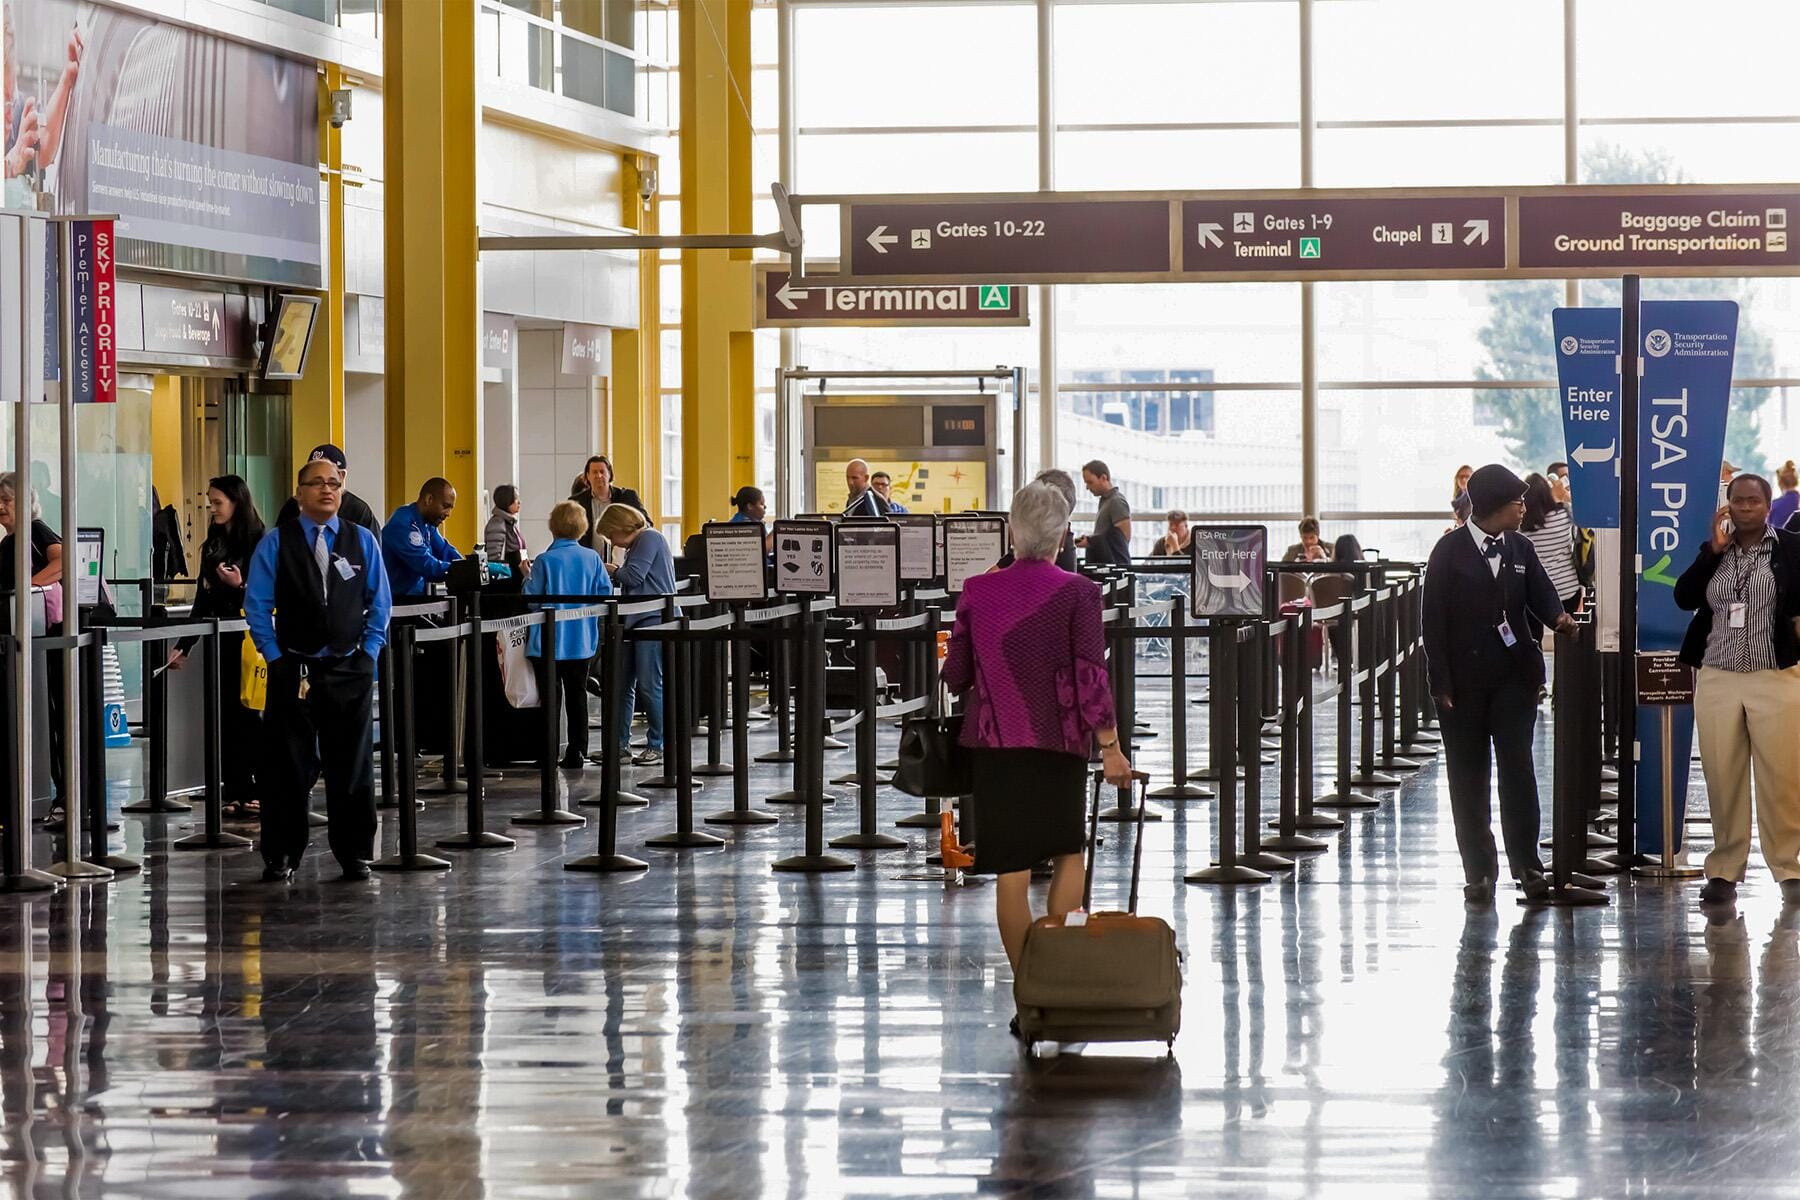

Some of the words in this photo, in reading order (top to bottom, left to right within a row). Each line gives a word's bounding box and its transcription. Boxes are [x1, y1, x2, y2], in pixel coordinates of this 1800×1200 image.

[92, 139, 150, 182] Manufacturing
[152, 150, 173, 179] that's
[174, 157, 203, 191] turning
[204, 161, 216, 187] the
[218, 170, 240, 192] corner
[241, 168, 268, 196] without
[268, 172, 295, 208] slowing
[295, 178, 316, 206] down.
[936, 221, 988, 238] Gates
[994, 220, 1046, 237] 10-22
[1264, 214, 1306, 231] Gates
[1312, 214, 1333, 230] 1-9
[1620, 211, 1702, 232] Baggage
[1706, 210, 1761, 228] Claim
[1372, 226, 1422, 246] Chapel
[1554, 234, 1624, 252] Ground
[1628, 234, 1761, 254] Transportation
[96, 232, 111, 274] SKY
[1234, 240, 1292, 257] Terminal
[1303, 241, 1318, 256] A
[77, 234, 89, 316] Premier
[984, 286, 1006, 308] A
[98, 282, 112, 392] PRIORITY
[188, 324, 210, 346] Beverage
[1674, 332, 1728, 341] Transportation
[79, 322, 89, 393] Access
[572, 338, 586, 358] Gates
[1568, 386, 1613, 402] Enter
[1570, 405, 1610, 421] Here
[1651, 388, 1688, 470] TSA
[1650, 483, 1687, 552] Pre
[1198, 532, 1213, 540] TSA
[1214, 531, 1227, 539] Pre
[1201, 549, 1229, 560] Enter
[1232, 549, 1256, 560] Here
